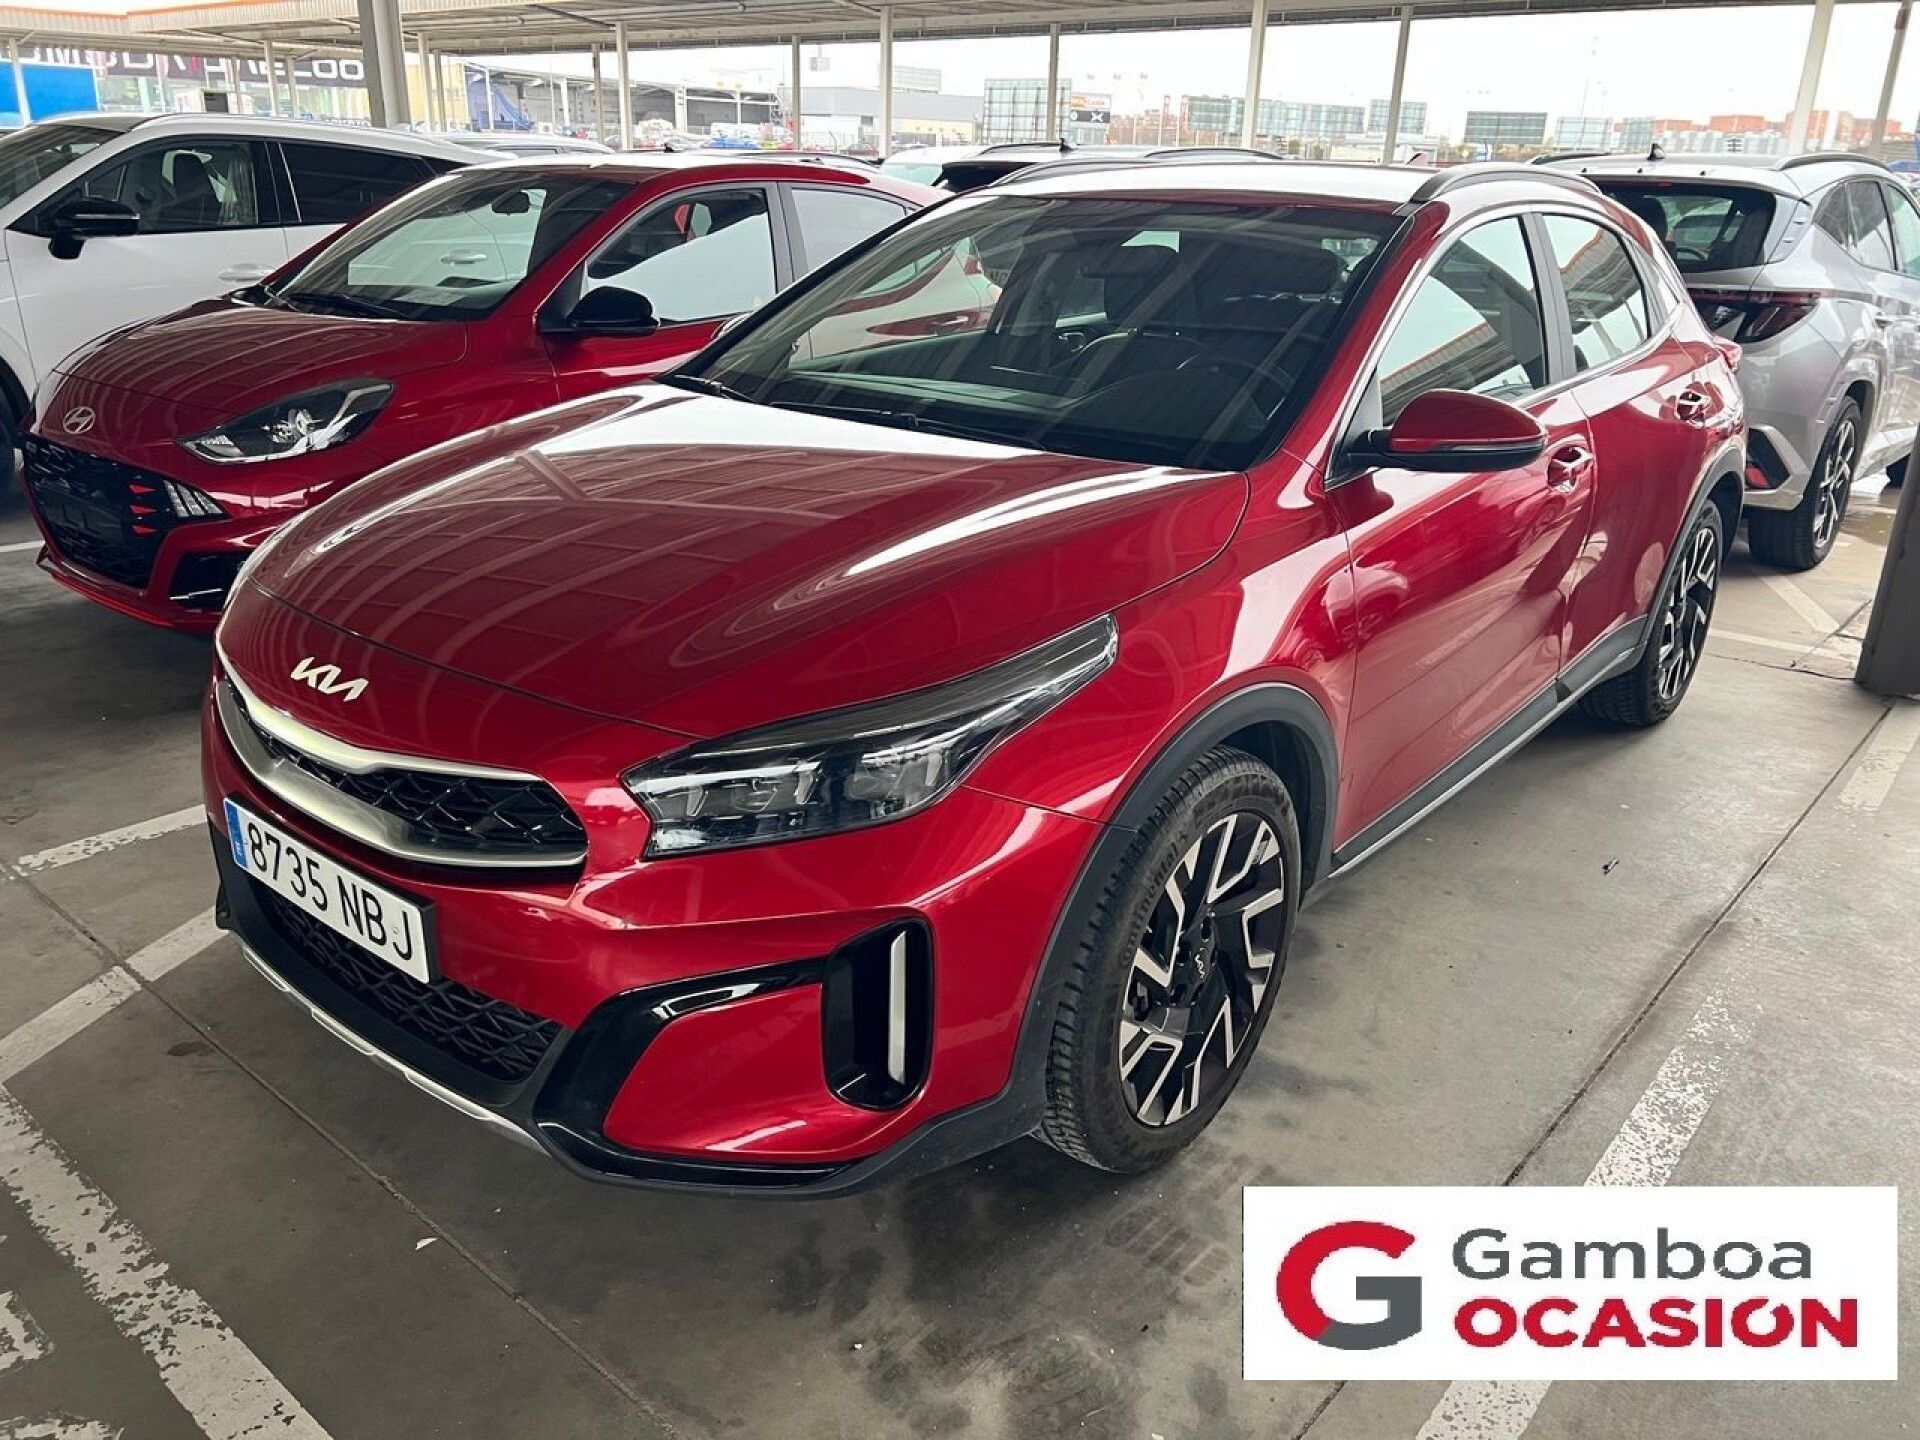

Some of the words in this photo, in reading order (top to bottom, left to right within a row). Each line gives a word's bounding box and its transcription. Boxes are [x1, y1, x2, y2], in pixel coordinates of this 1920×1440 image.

[291, 657, 368, 701] KIA
[248, 823, 327, 911] 8735
[338, 874, 412, 960] NBJ
